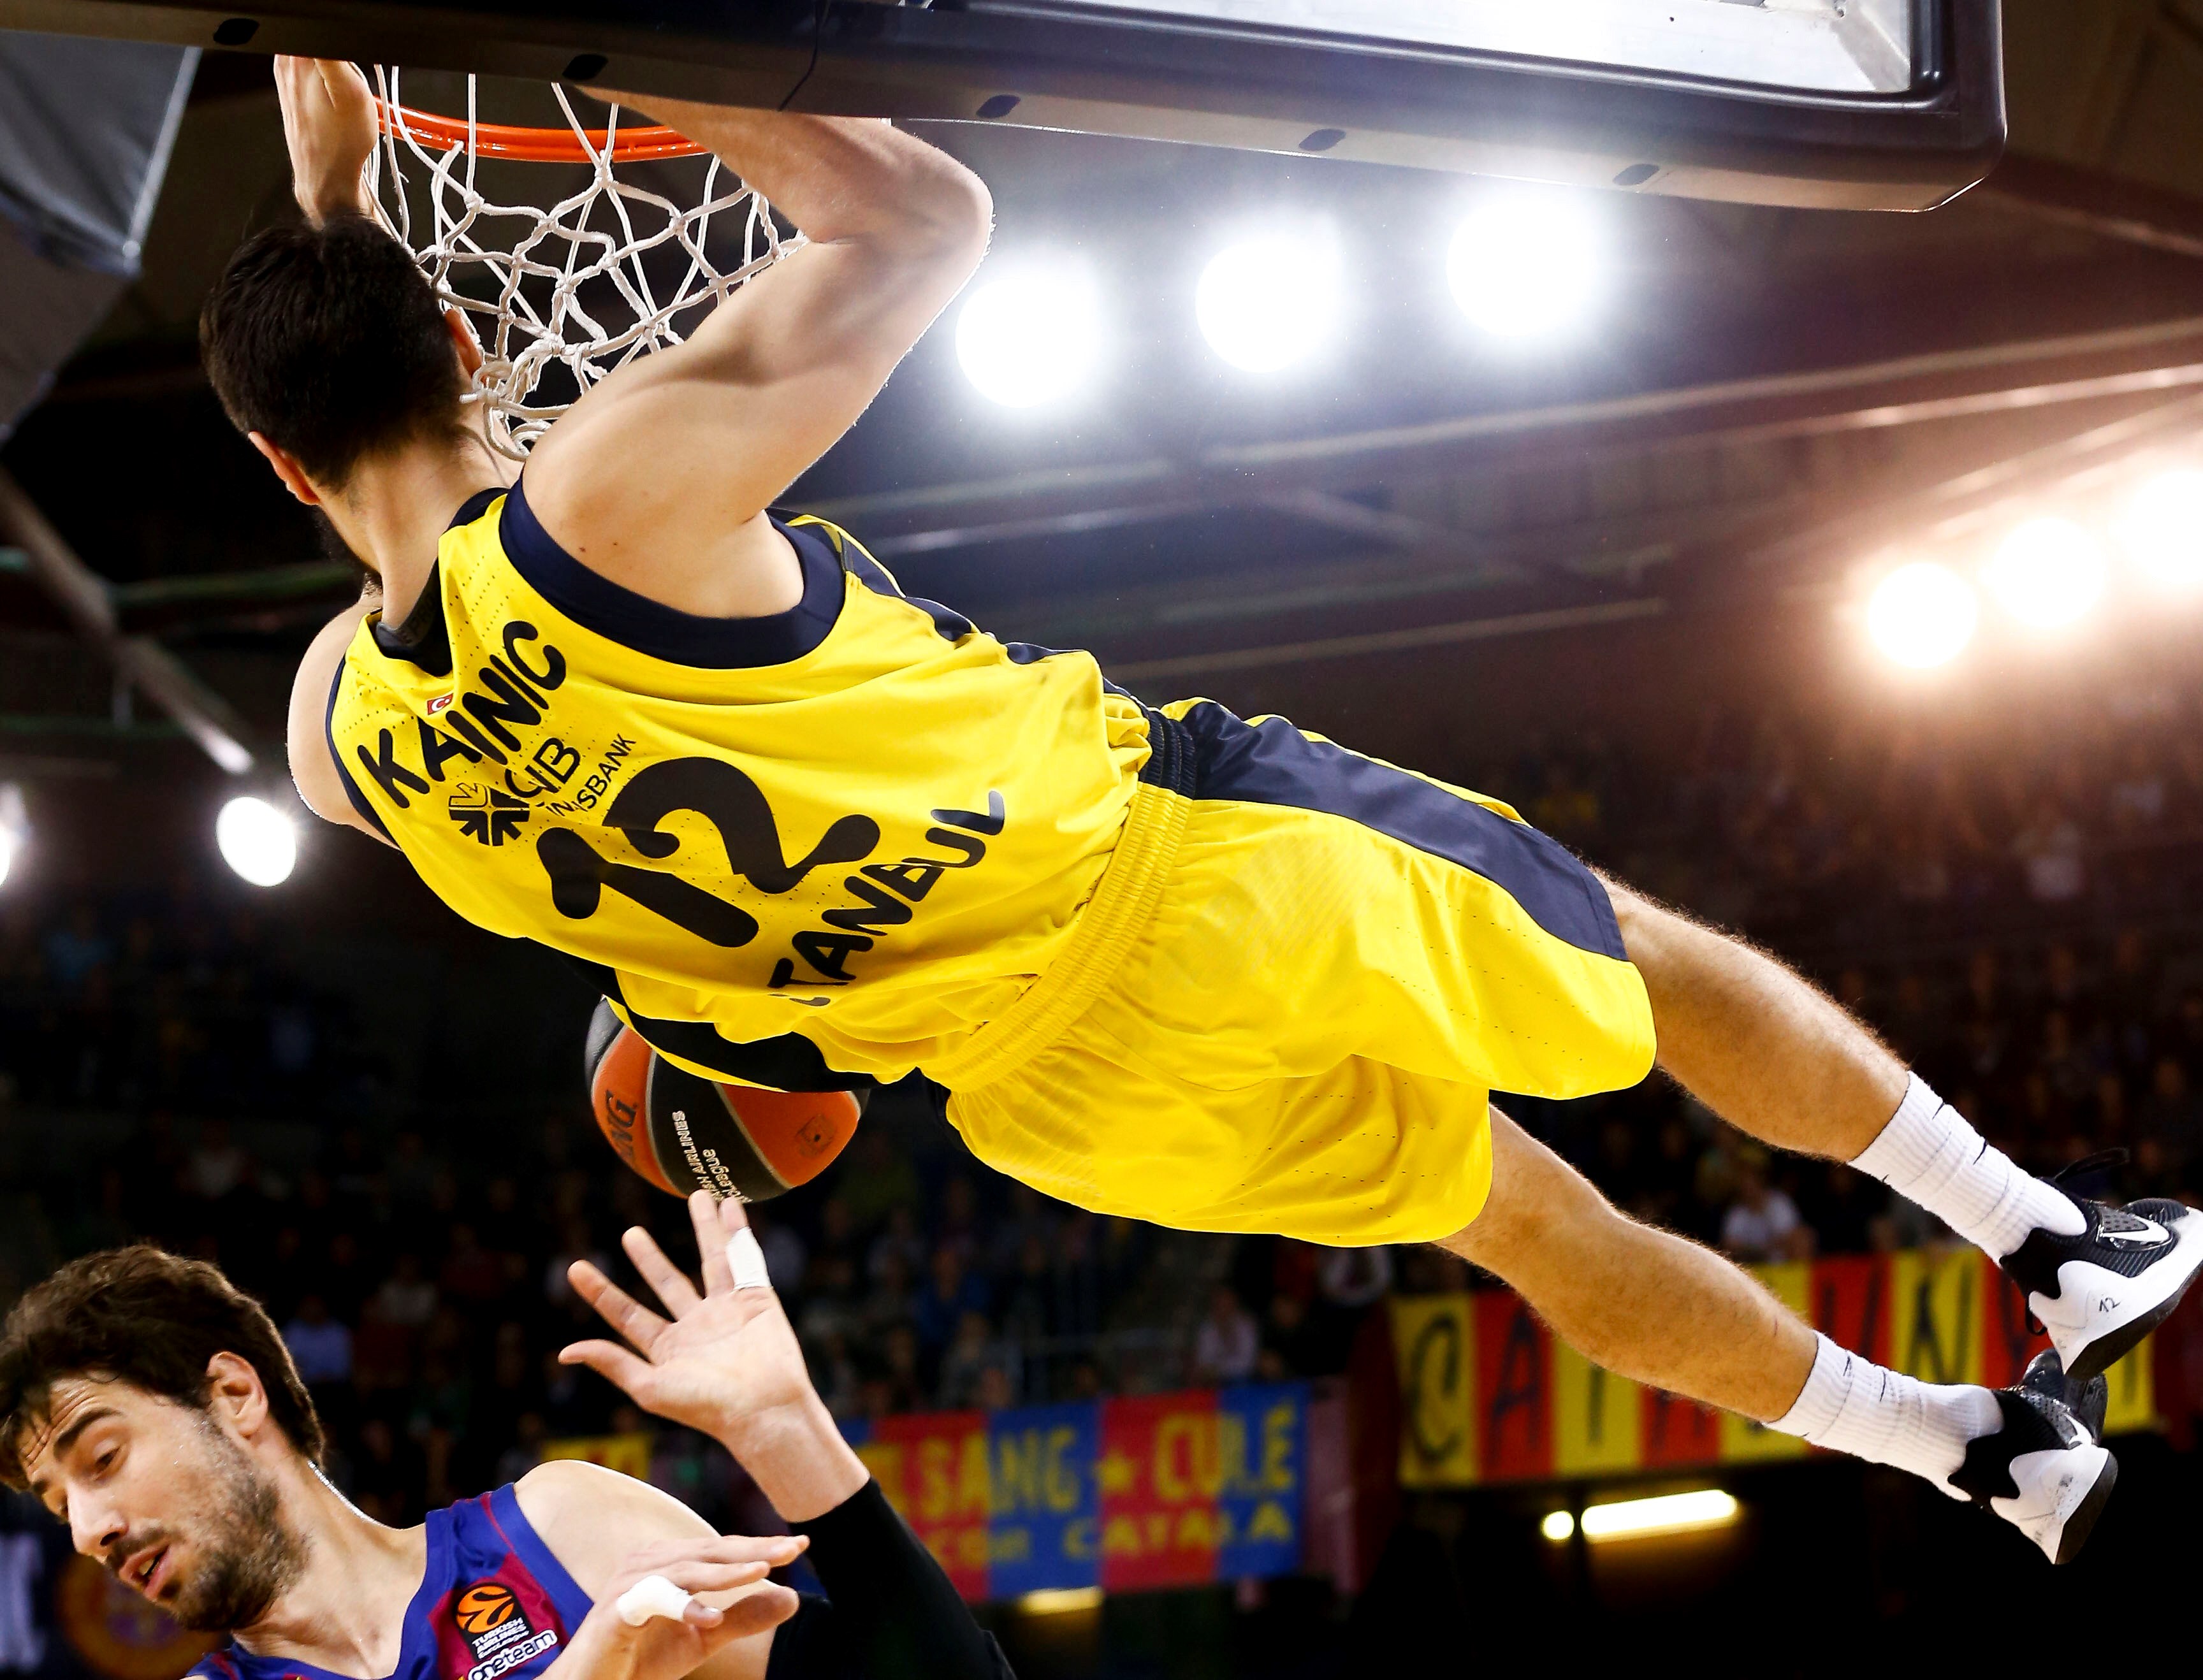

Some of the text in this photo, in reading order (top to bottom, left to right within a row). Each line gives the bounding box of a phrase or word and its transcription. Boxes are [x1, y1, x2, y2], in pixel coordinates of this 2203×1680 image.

[536, 756, 880, 948] 12
[672, 1110, 707, 1174] AIRLINES
[2098, 1297, 2122, 1313] 12
[470, 1631, 555, 1680] oneteam
